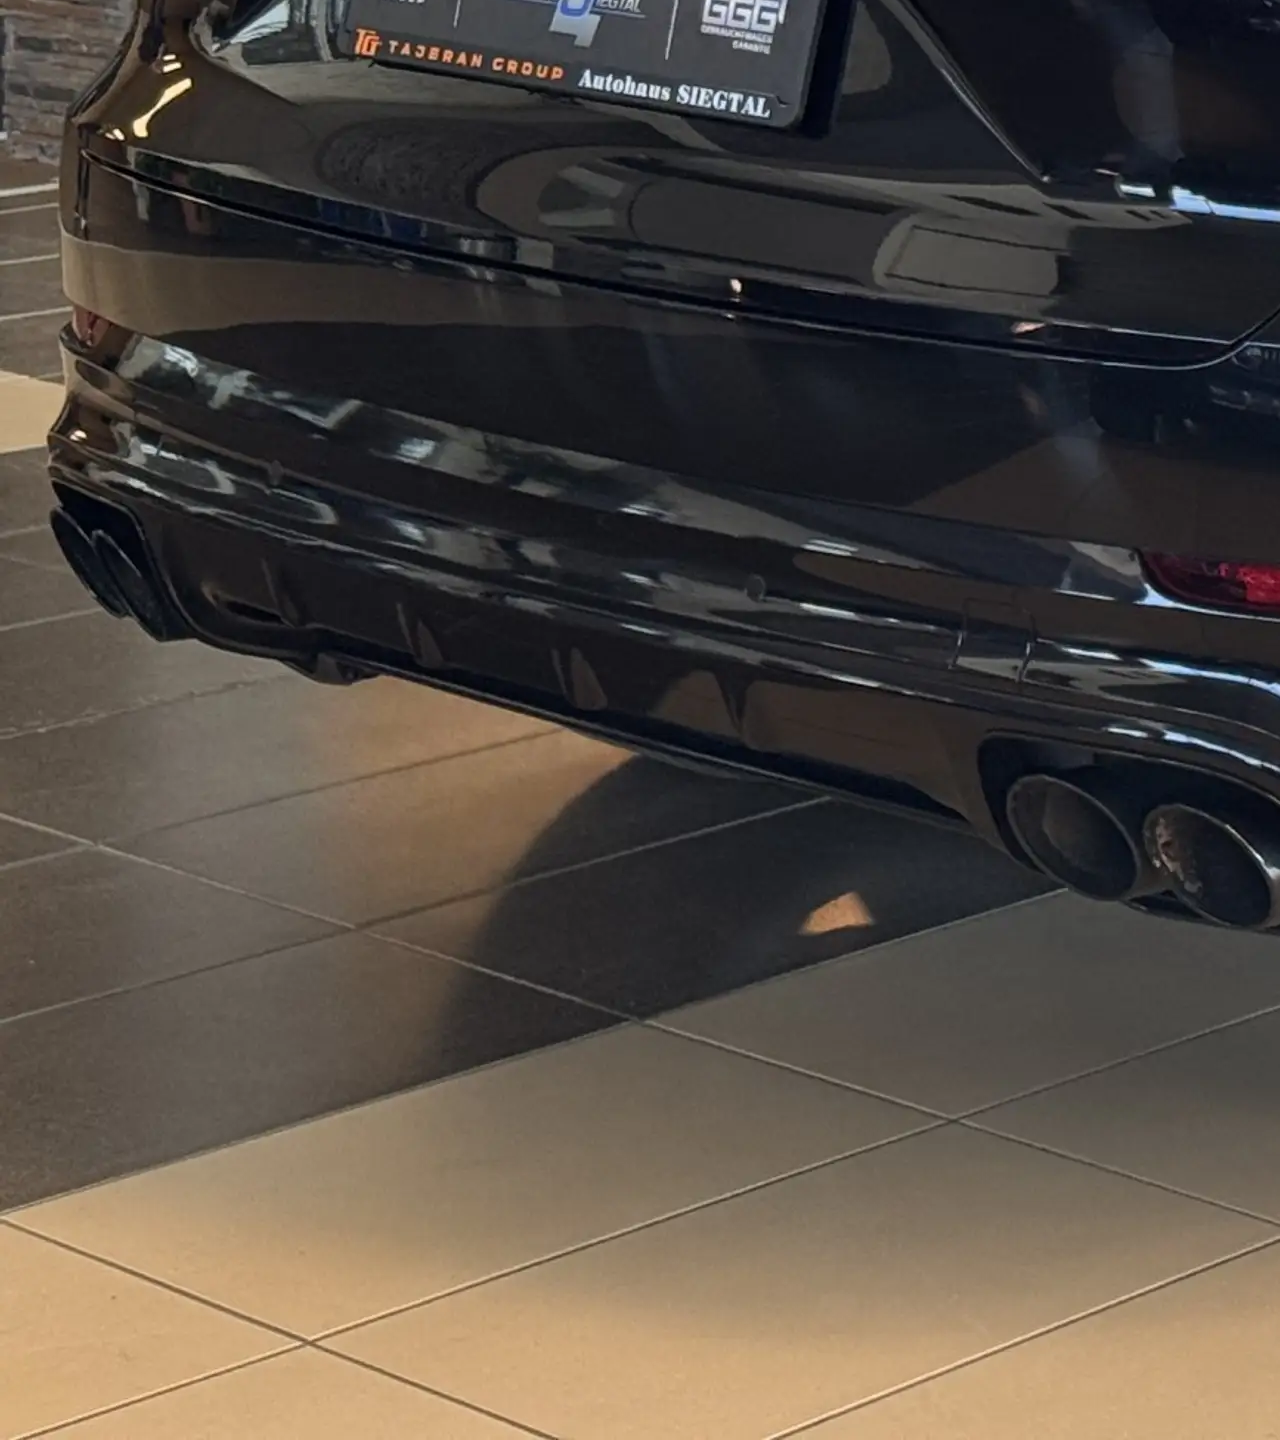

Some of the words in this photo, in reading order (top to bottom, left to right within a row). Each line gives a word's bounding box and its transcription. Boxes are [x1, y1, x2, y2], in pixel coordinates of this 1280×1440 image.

[388, 39, 484, 69] TAJERAN
[491, 57, 565, 81] GROUP
[577, 68, 672, 101] Autohaus
[676, 83, 772, 119] SIEGTAL
